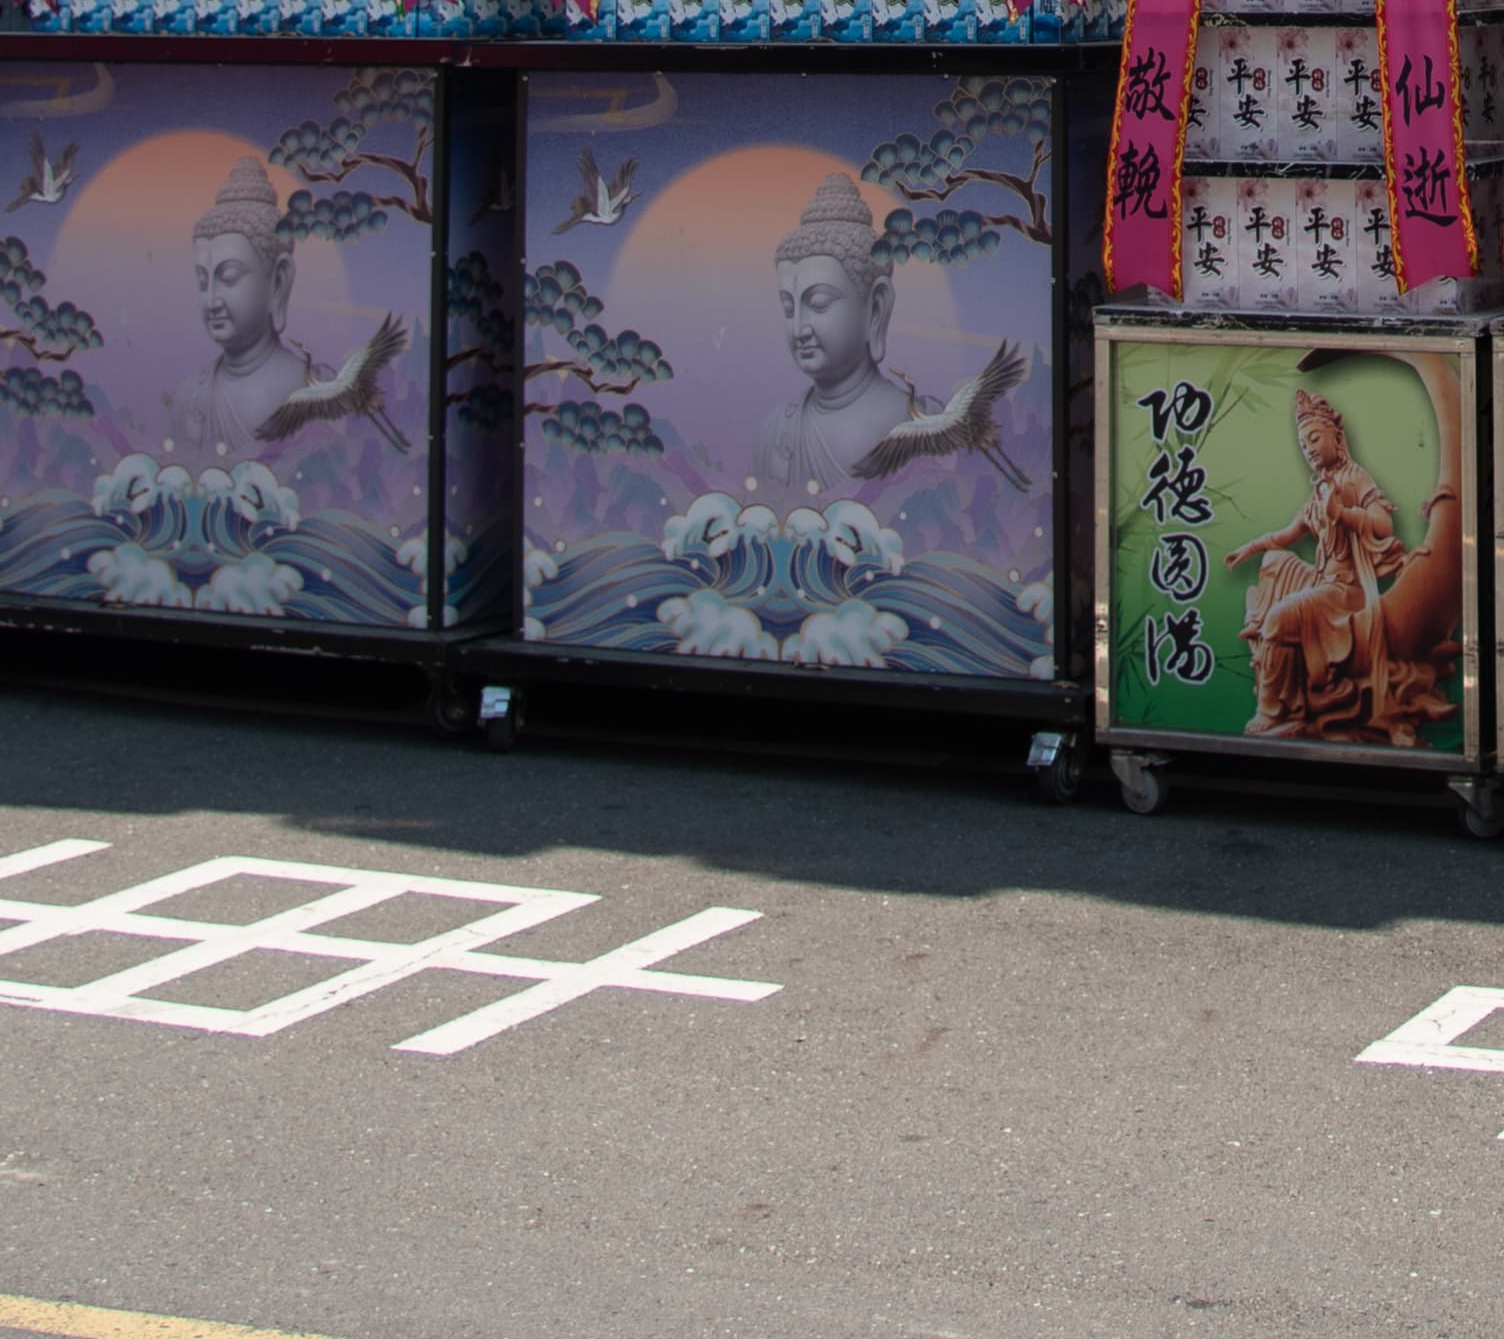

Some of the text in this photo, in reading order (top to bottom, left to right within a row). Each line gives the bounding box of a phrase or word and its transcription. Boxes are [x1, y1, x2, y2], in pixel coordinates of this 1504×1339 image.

[1226, 59, 1266, 127] 平安
[1284, 60, 1324, 128] 平安
[1115, 46, 1175, 220] 敬輓
[1245, 208, 1285, 276] 平安
[1304, 209, 1344, 277] 平安
